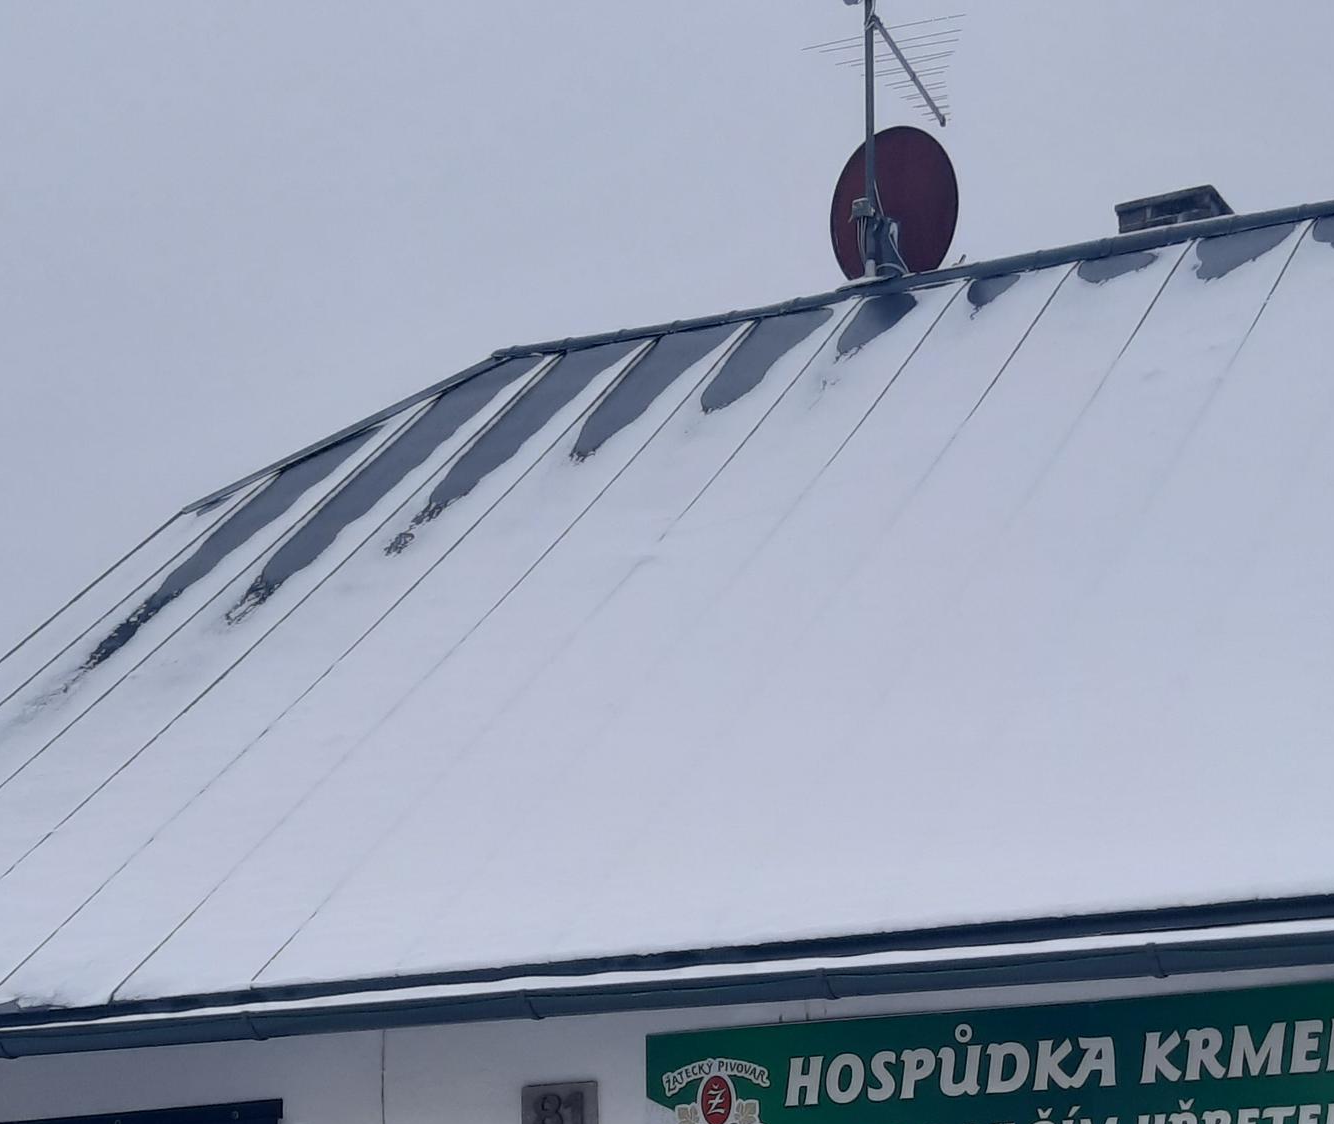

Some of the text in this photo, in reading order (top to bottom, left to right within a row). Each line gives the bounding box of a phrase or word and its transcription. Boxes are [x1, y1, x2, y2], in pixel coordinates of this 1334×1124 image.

[665, 1060, 767, 1093] ŽATECKÝ PIVOVAR
[784, 1023, 1117, 1108] HOSPŮDKA
[707, 1082, 727, 1115] Ž
